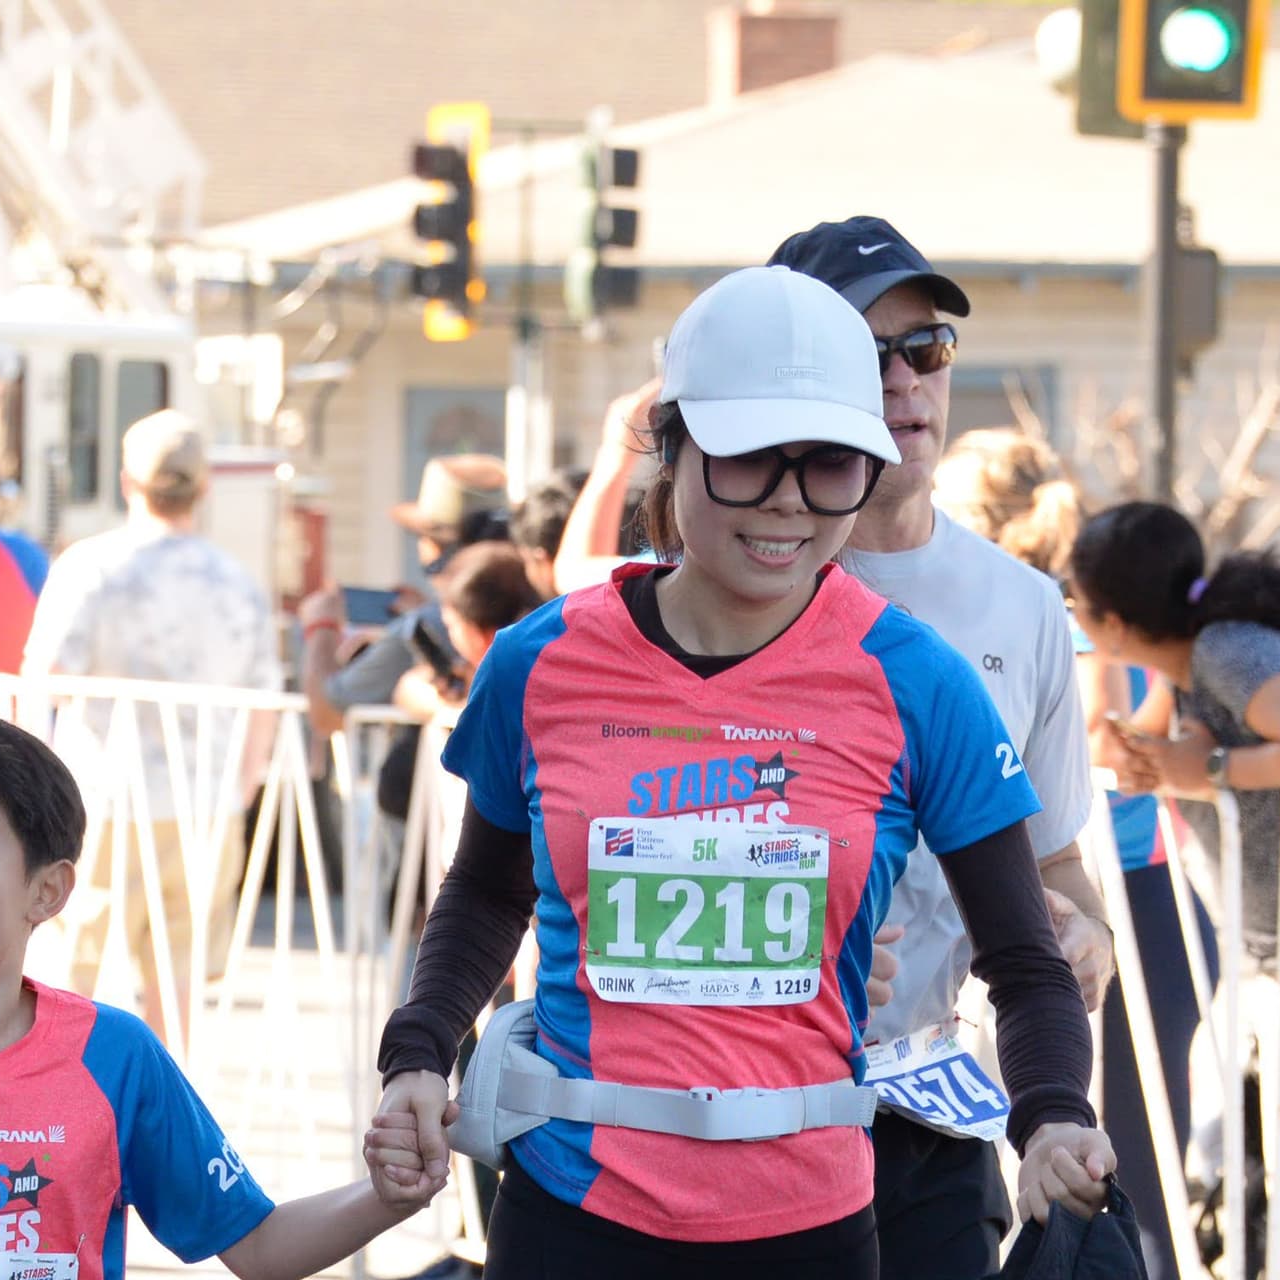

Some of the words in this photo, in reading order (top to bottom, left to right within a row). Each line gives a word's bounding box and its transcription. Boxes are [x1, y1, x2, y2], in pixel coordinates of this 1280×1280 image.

[982, 654, 1004, 674] OR
[602, 724, 704, 742] Bloomenergy
[720, 725, 795, 741] TARANA
[628, 755, 757, 816] STARS
[760, 767, 785, 785] AND
[693, 838, 718, 862] 5K
[765, 839, 793, 852] STARS
[763, 850, 799, 865] STRIDES
[606, 877, 811, 963] 1219
[598, 977, 635, 993] DRINK
[700, 984, 740, 993] HAPA'S
[776, 978, 812, 995] 1219
[894, 1036, 913, 1062] 10K
[873, 1060, 1006, 1123] 2574
[14, 1175, 39, 1194] AND
[23, 1268, 49, 1280] STARS
